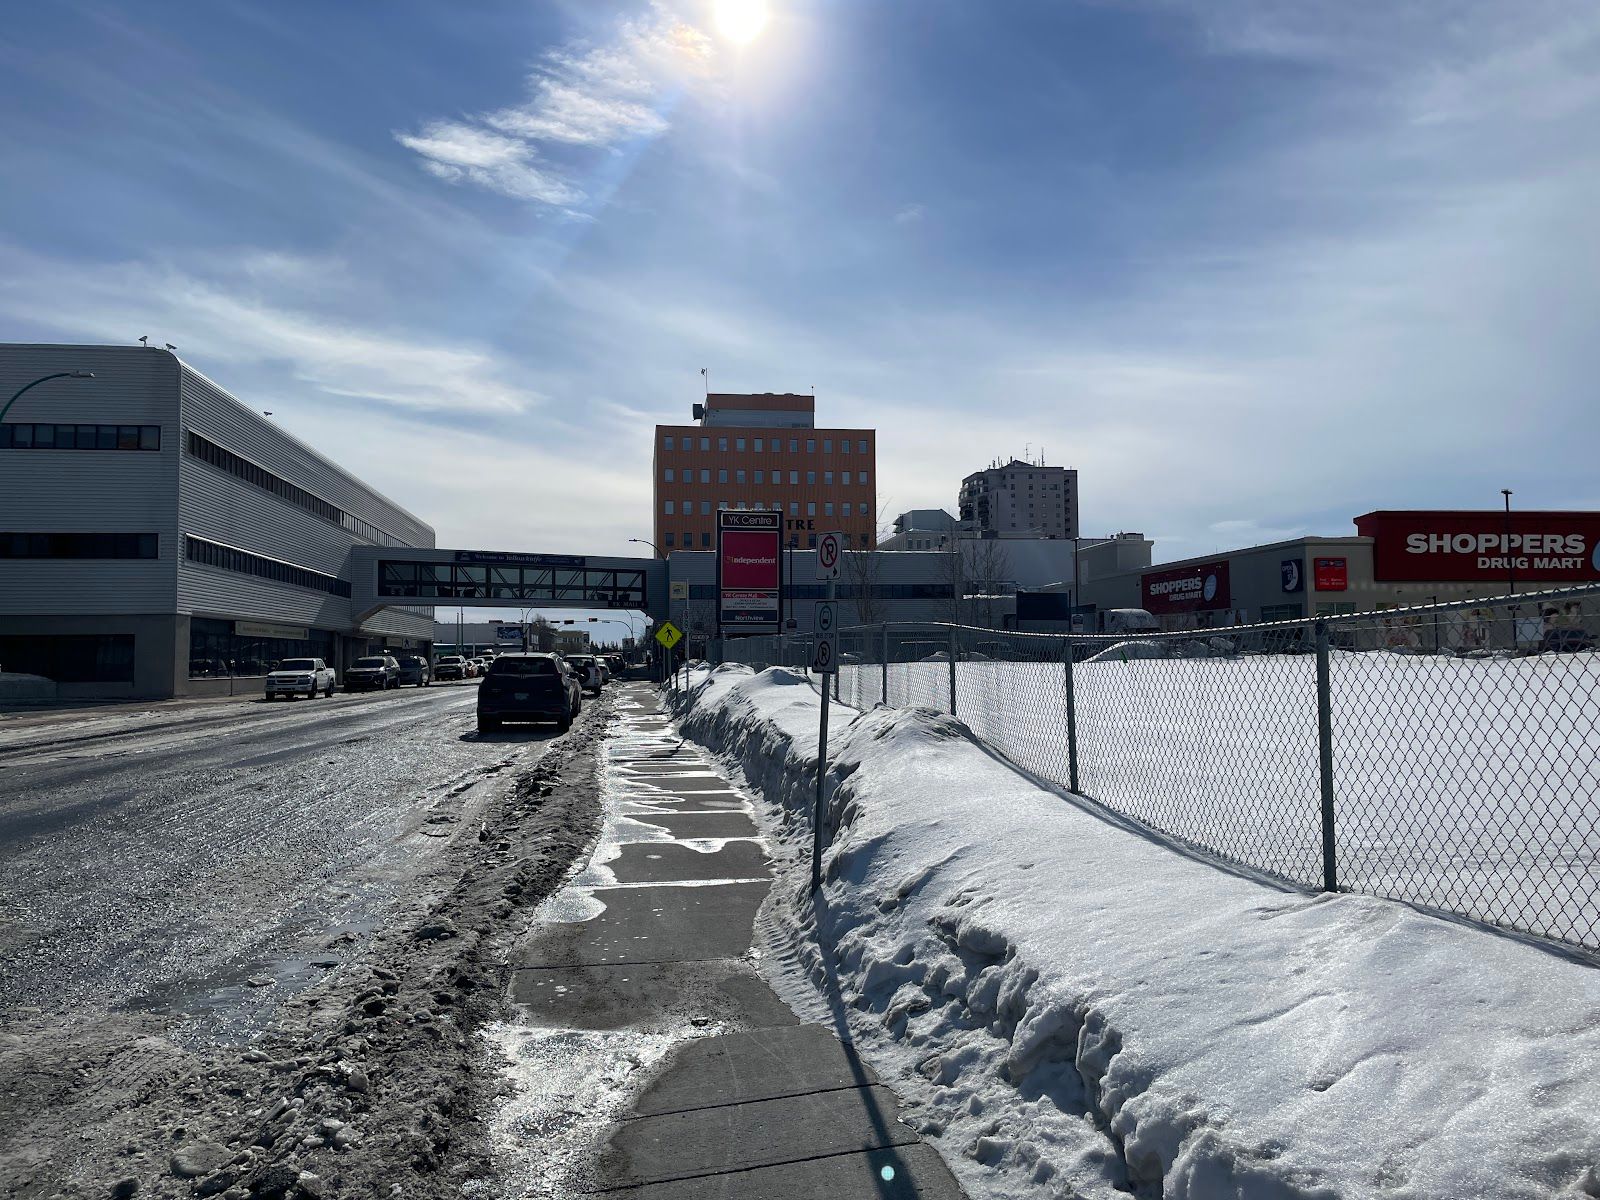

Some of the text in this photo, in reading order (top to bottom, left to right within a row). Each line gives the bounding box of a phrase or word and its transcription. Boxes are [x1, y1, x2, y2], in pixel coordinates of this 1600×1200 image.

[728, 515, 772, 524] YK Centre
[1405, 533, 1586, 554] SHOPPERS
[505, 554, 543, 564] Yellowknife
[1477, 556, 1585, 569] DRUG MART
[1150, 577, 1201, 595] SHOPPERS
[1168, 590, 1203, 602] DRUG MART
